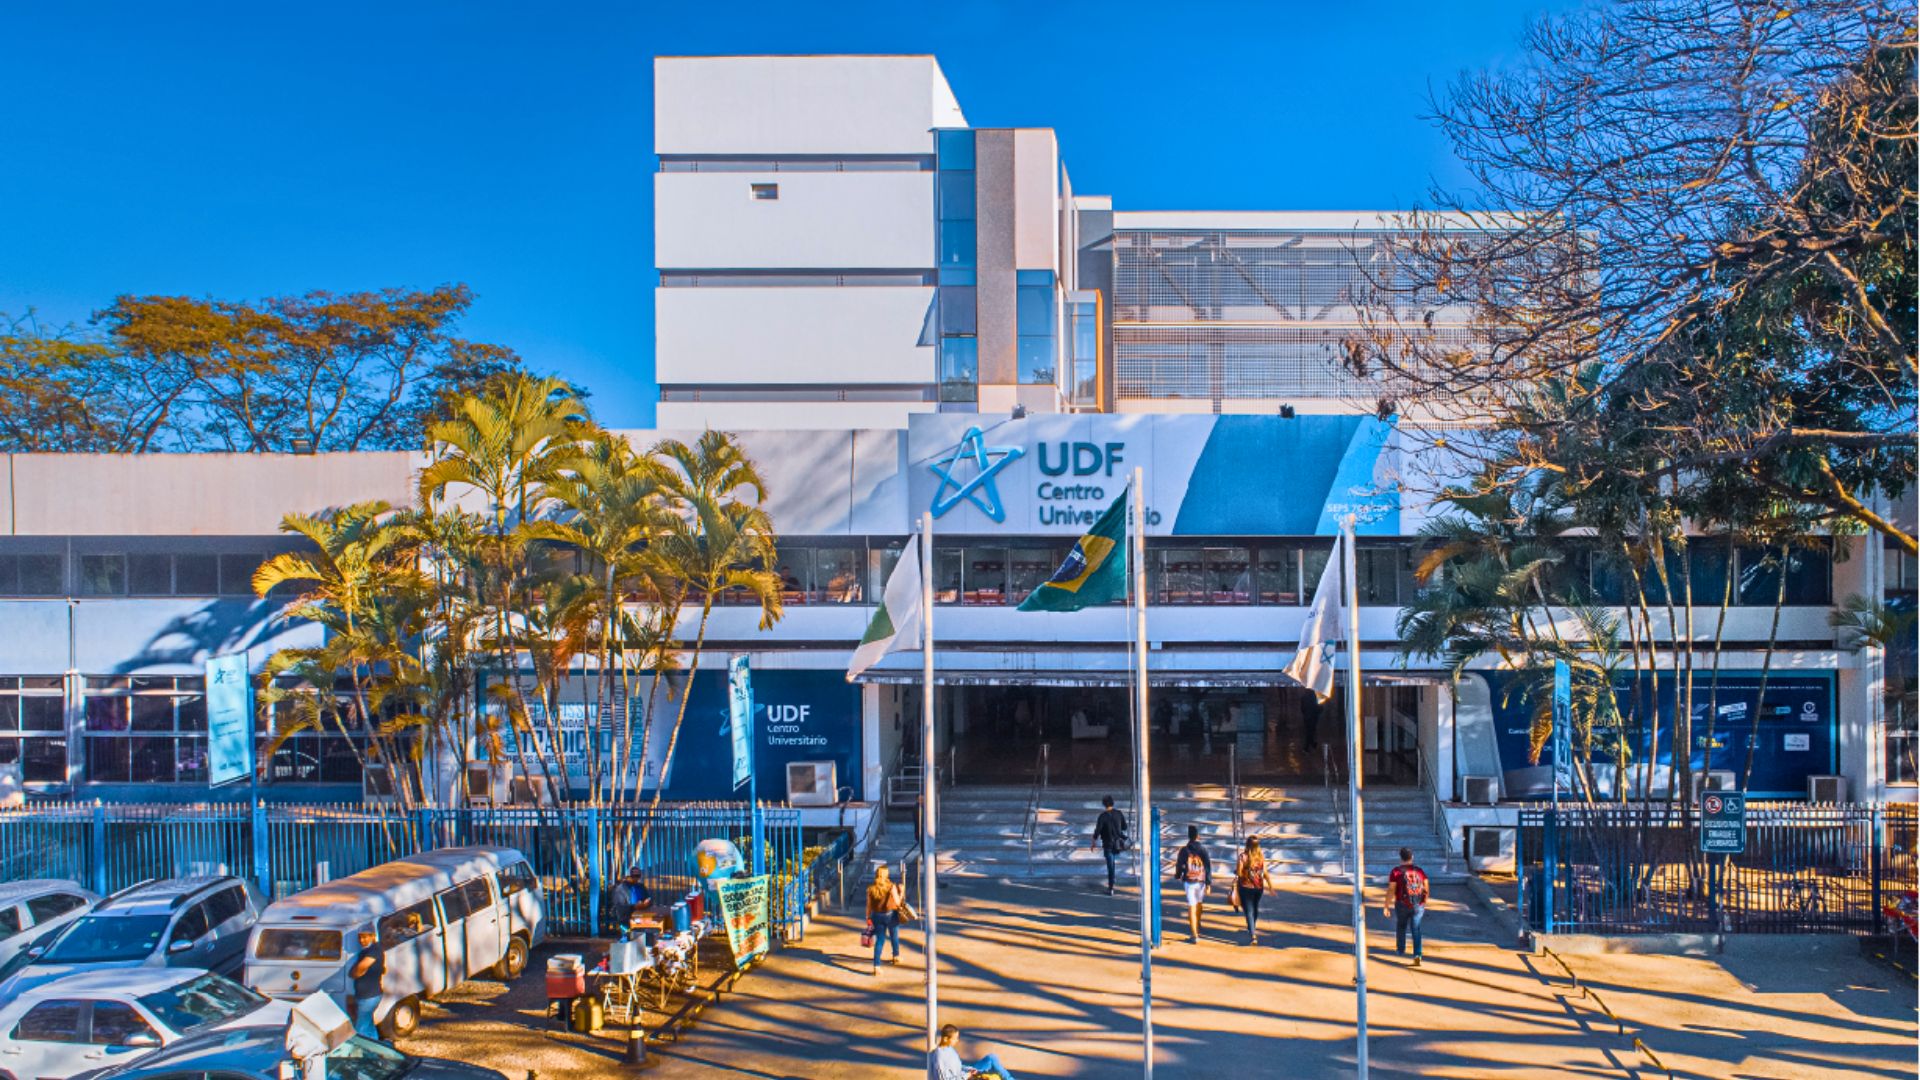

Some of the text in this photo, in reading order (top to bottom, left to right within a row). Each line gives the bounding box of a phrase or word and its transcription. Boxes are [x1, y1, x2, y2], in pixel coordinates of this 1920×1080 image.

[1038, 442, 1125, 477] UDF
[1037, 482, 1104, 500] Centro
[767, 705, 810, 722] UDF
[767, 725, 799, 733] Centro
[768, 735, 828, 745] Universitário
